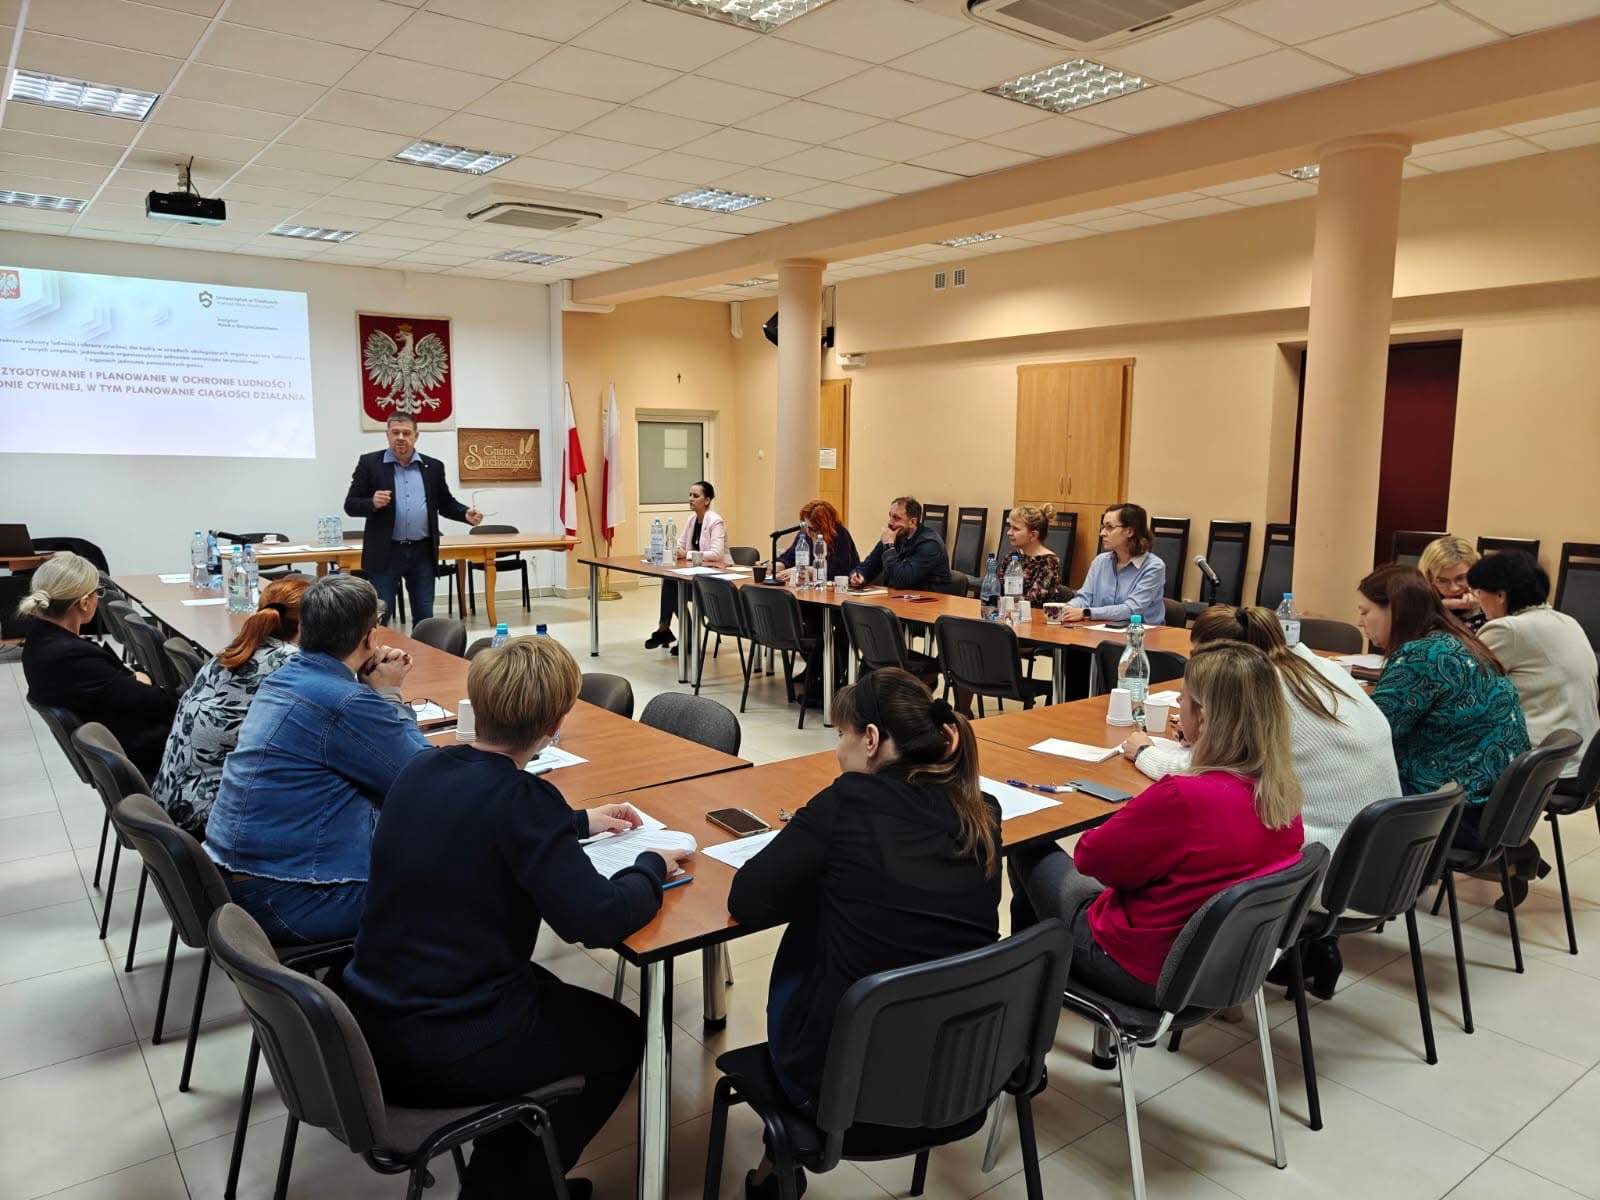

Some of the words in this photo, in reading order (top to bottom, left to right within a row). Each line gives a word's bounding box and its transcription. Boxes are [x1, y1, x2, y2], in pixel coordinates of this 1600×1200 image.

[96, 371, 167, 383] PLANOWANIE
[170, 375, 179, 383] W
[182, 375, 236, 386] OCHRONIE
[87, 383, 96, 392] W
[99, 384, 122, 393] TYM
[126, 385, 196, 396] PLANOWANIE
